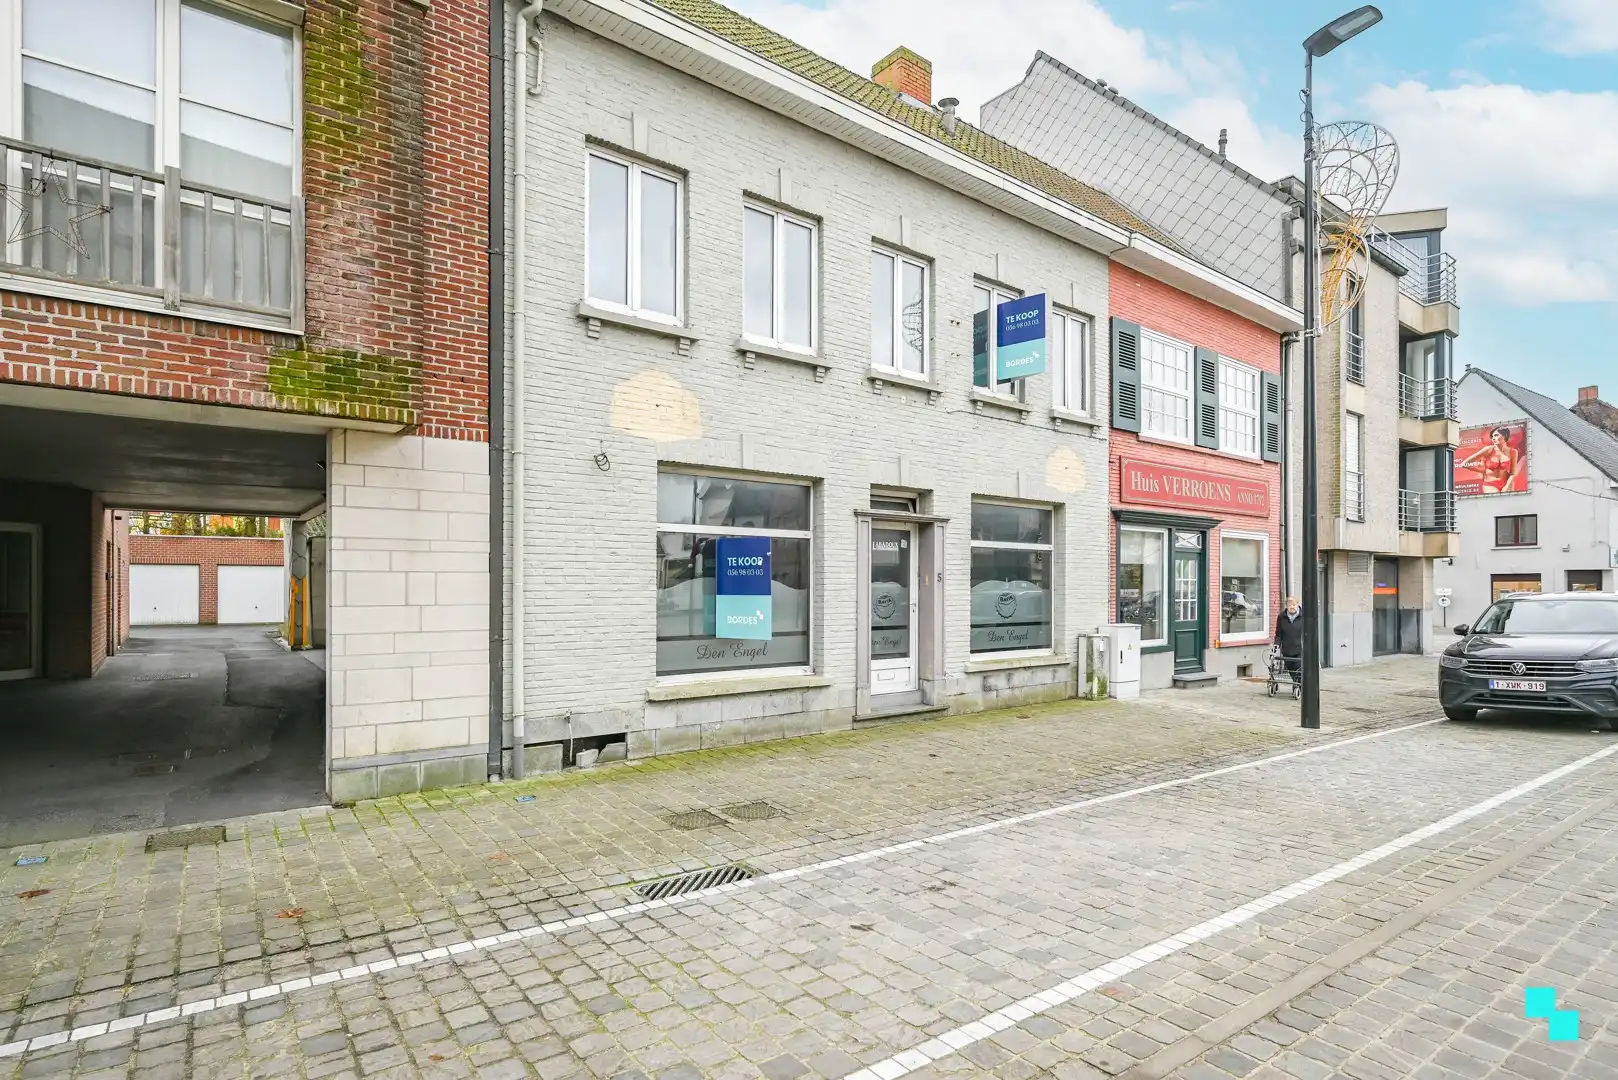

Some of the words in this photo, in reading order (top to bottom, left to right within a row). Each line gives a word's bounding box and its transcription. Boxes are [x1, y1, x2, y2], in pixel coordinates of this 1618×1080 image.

[1016, 310, 1039, 321] KOOP
[1005, 356, 1034, 368] BORDES
[1131, 470, 1160, 493] Huis
[1162, 474, 1232, 502] VERROENS
[1236, 491, 1253, 505] ANNO
[727, 557, 737, 566] TE
[738, 557, 764, 566] KOOP
[727, 568, 738, 576] 056
[739, 568, 747, 576] 98
[747, 568, 755, 576] 03
[755, 568, 764, 576] 03
[937, 572, 943, 582] 5
[727, 616, 758, 625] BORDES
[988, 630, 1005, 642] Den
[1006, 629, 1029, 645] Engel
[696, 644, 726, 660] Den
[729, 641, 769, 662] Engel
